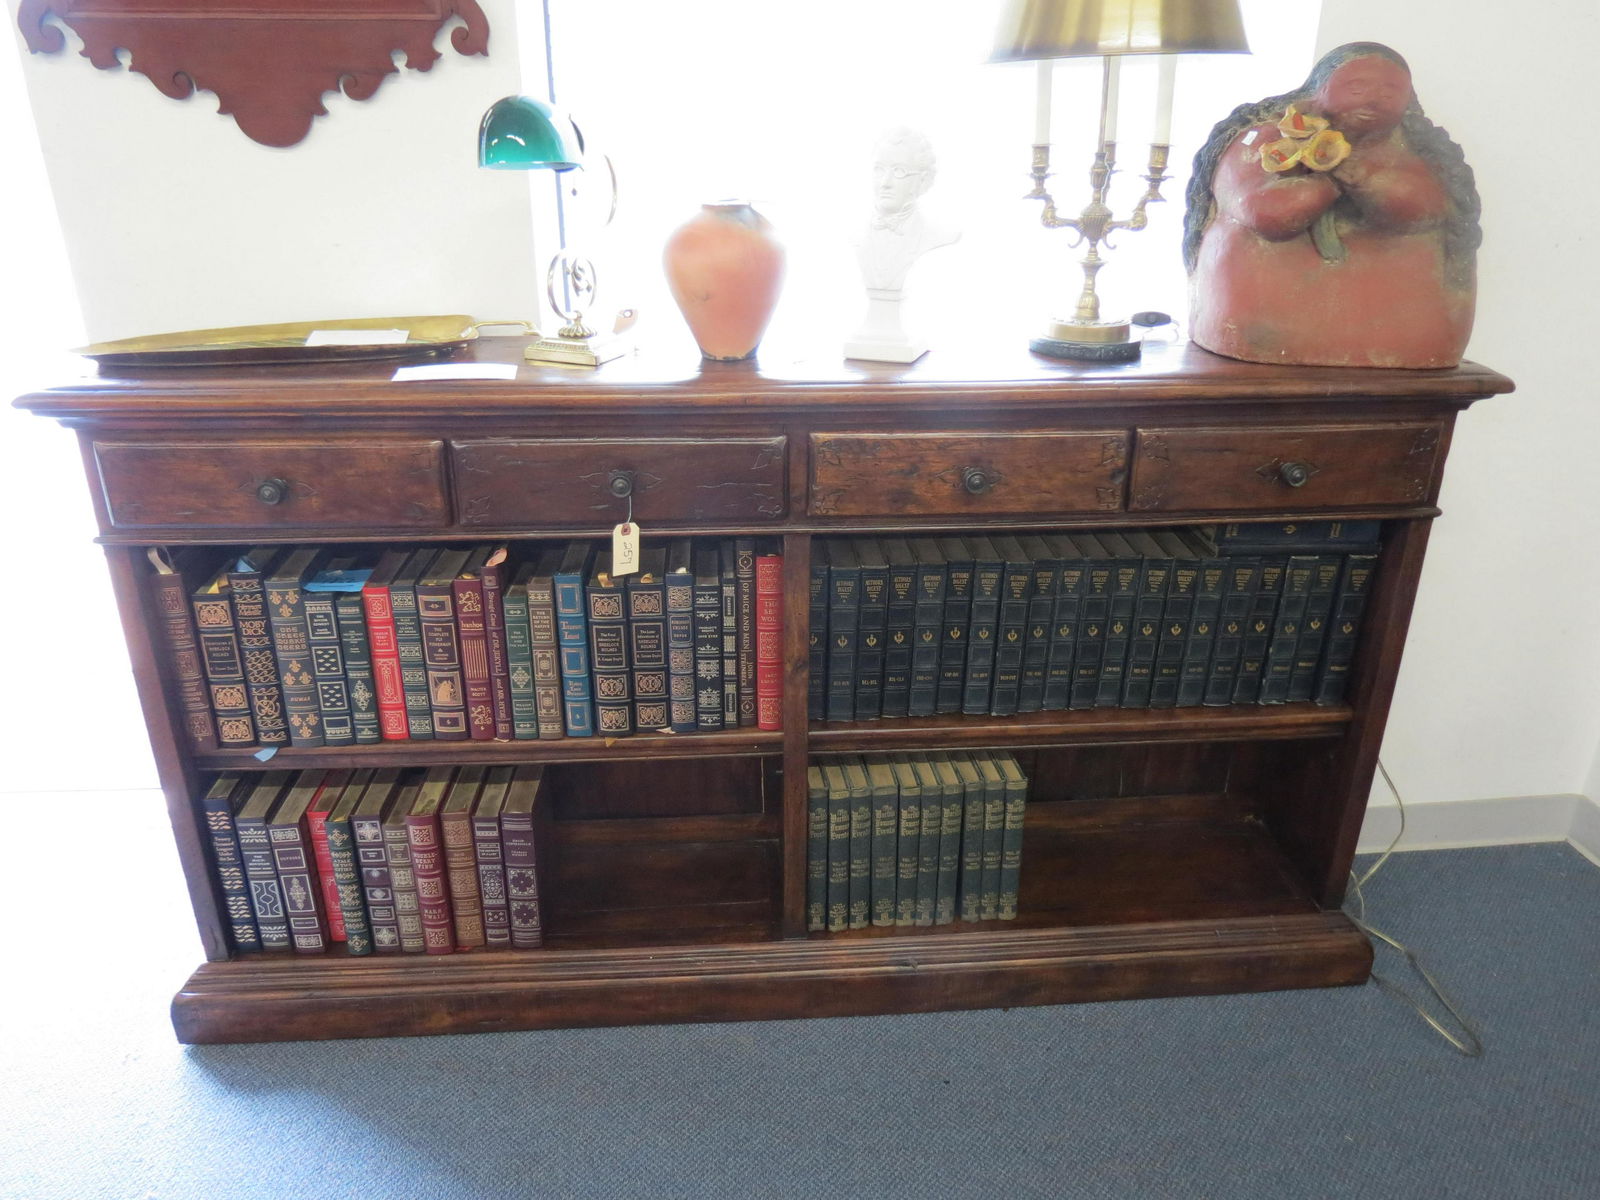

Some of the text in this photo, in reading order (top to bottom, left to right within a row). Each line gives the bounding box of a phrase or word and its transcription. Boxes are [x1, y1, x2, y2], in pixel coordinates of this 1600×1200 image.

[742, 582, 750, 593] OF
[488, 591, 496, 612] Strange
[742, 594, 750, 613] MICE
[240, 620, 266, 629] MOBY
[489, 613, 497, 627] Case
[243, 628, 266, 636] DICK
